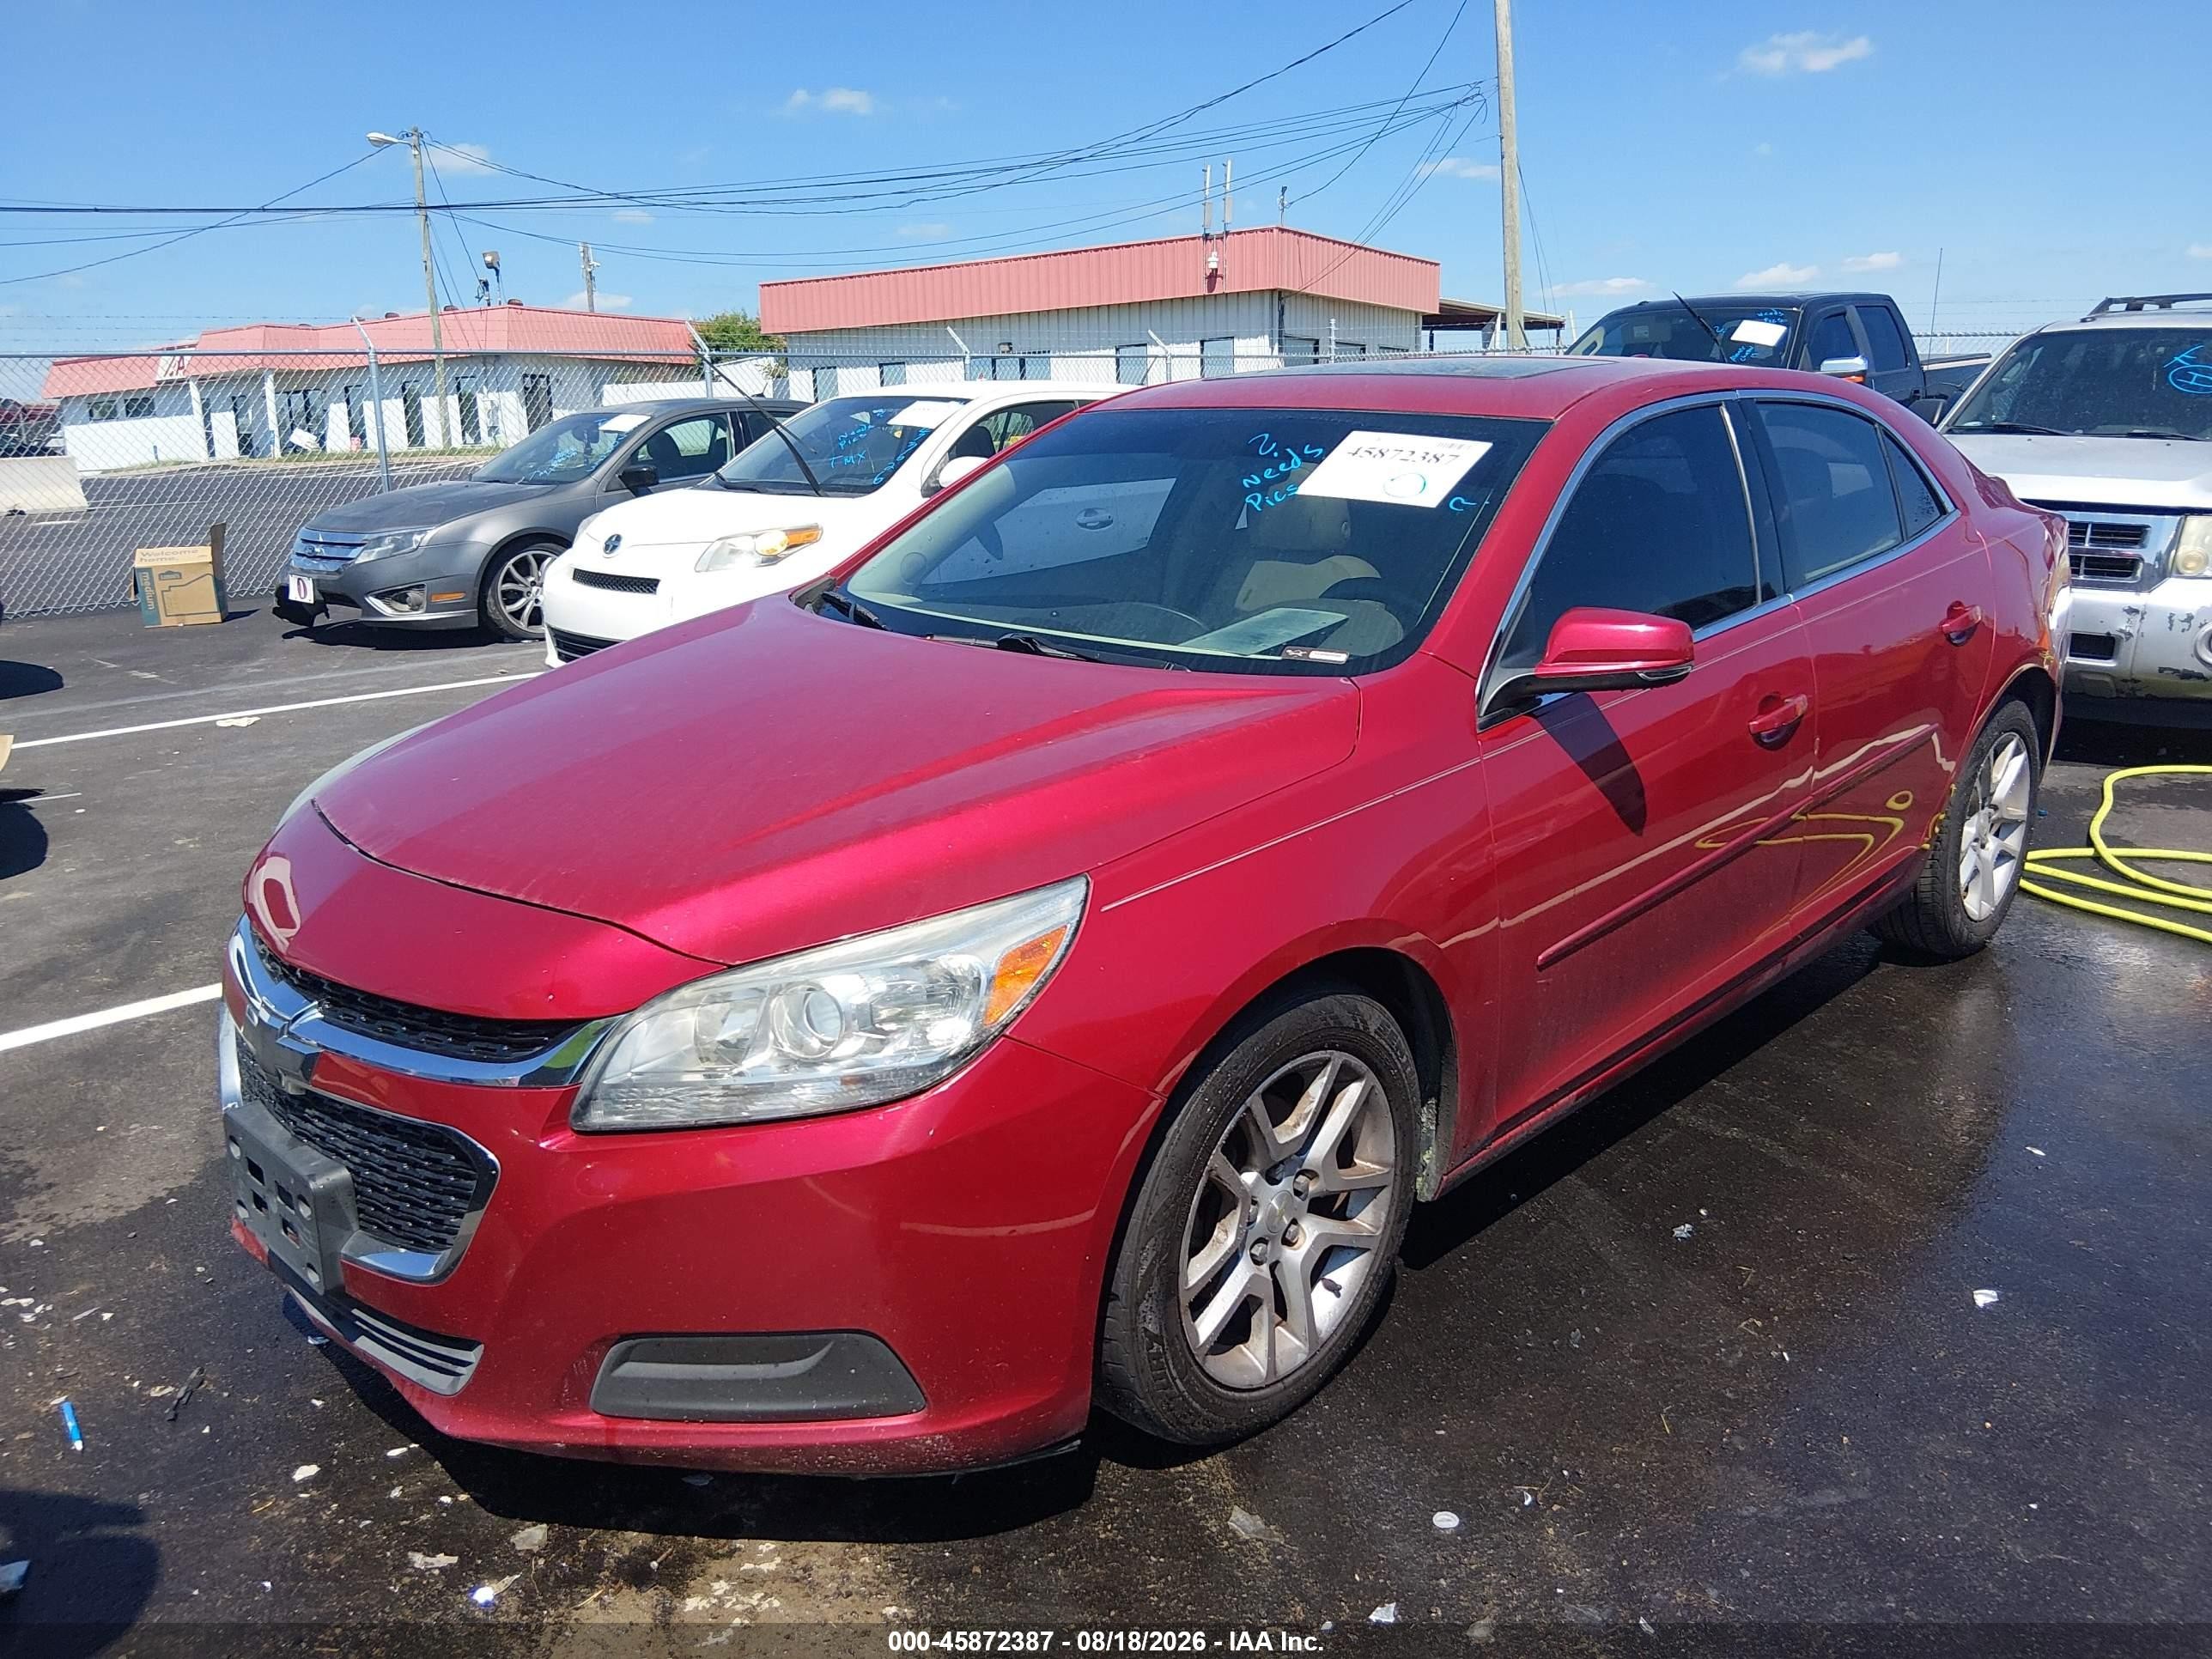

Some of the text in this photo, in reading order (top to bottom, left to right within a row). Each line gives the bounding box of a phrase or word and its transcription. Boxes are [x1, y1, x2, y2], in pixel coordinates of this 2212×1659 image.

[1243, 443, 1324, 489] Needs
[1347, 446, 1461, 465] 45872387
[1245, 483, 1298, 512] Pics
[140, 549, 199, 557] Welcome
[141, 571, 155, 611] medium
